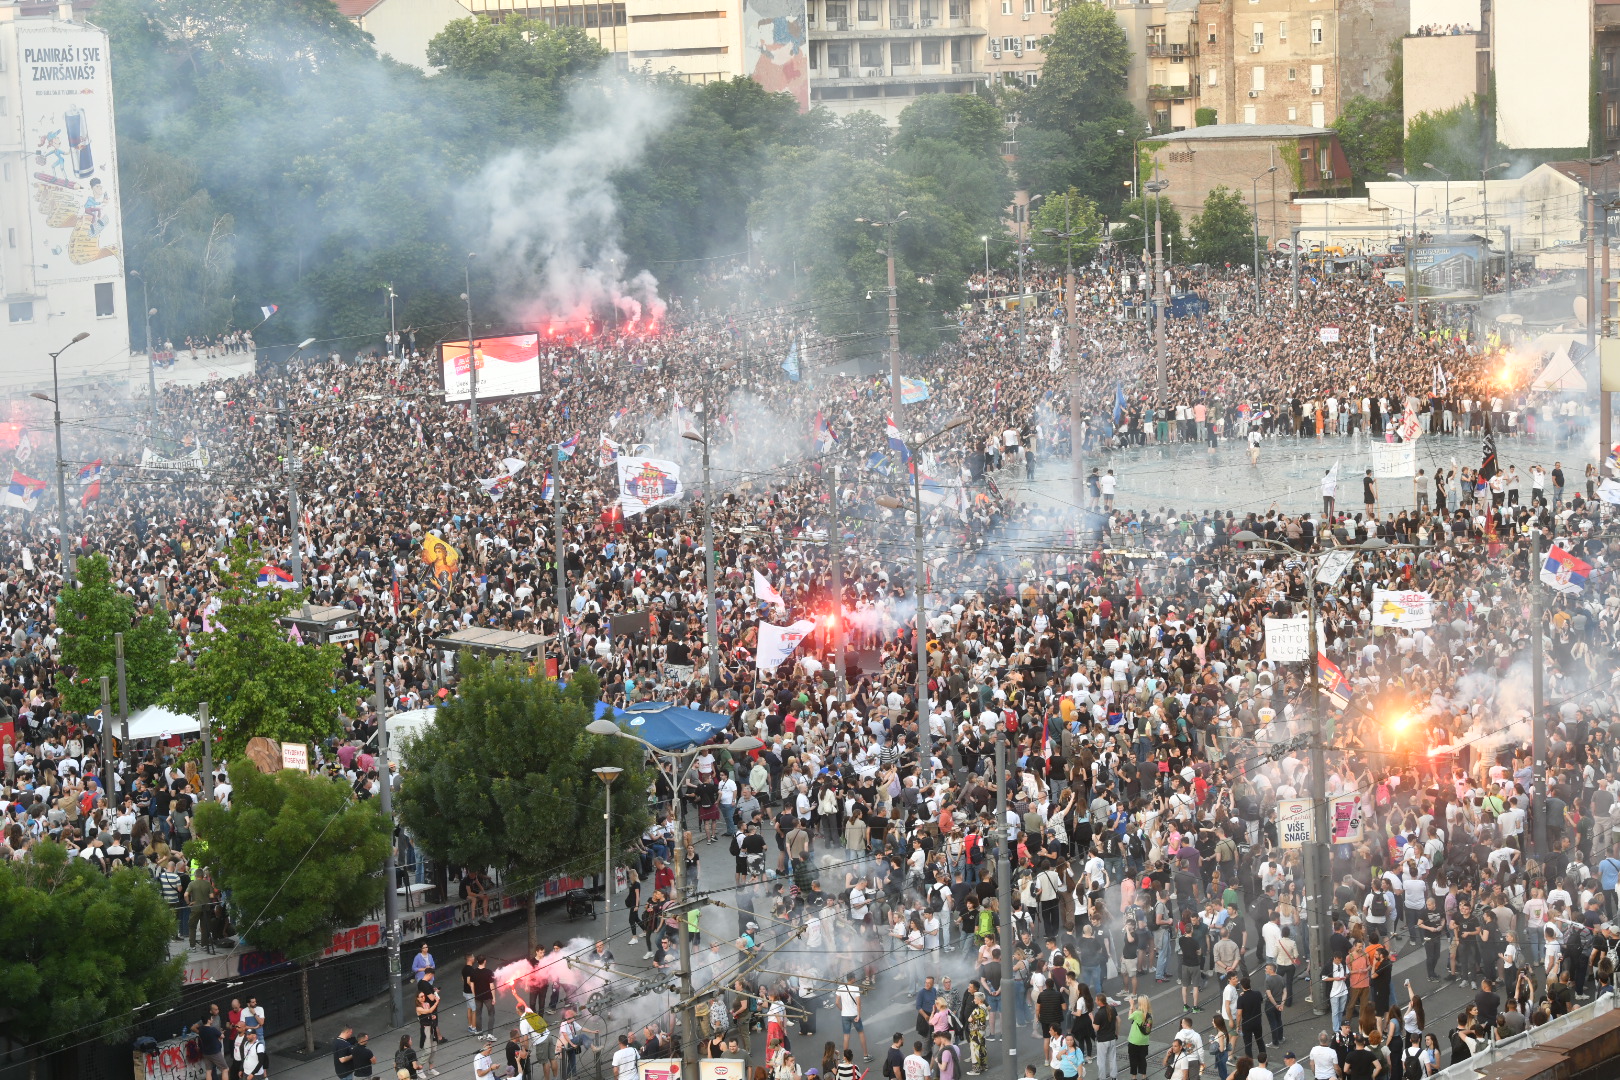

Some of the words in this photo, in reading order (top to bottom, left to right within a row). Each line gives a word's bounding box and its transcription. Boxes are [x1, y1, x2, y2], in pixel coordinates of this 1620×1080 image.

[25, 45, 73, 62] PLANIRAŠ
[77, 48, 80, 61] I
[83, 48, 100, 61] SVE
[32, 63, 95, 81] ZAVRŠAVAŠ?
[1284, 832, 1310, 842] SNAGE
